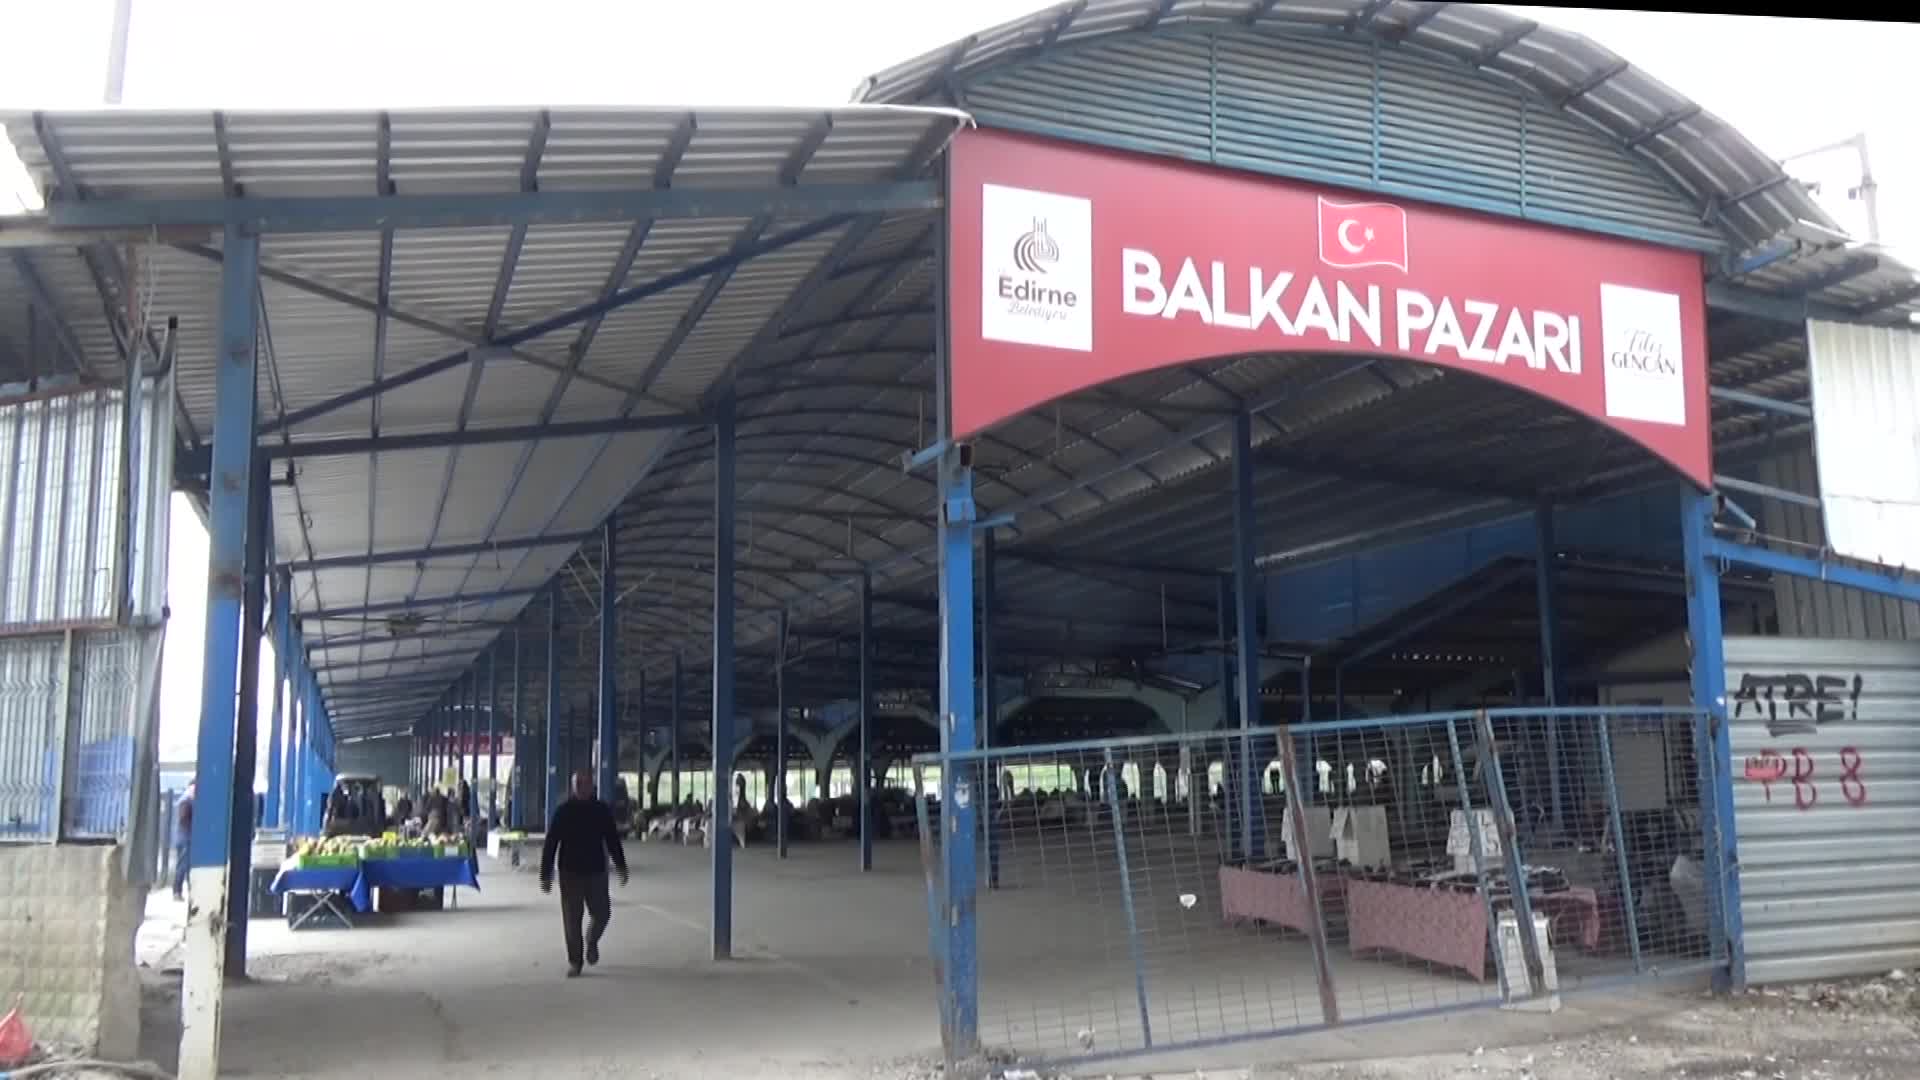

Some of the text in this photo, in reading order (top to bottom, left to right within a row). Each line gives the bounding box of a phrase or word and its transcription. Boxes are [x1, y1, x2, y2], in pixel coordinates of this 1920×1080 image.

[999, 275, 1077, 308] Edirne
[1121, 247, 1581, 375] BALKAN PAZARI
